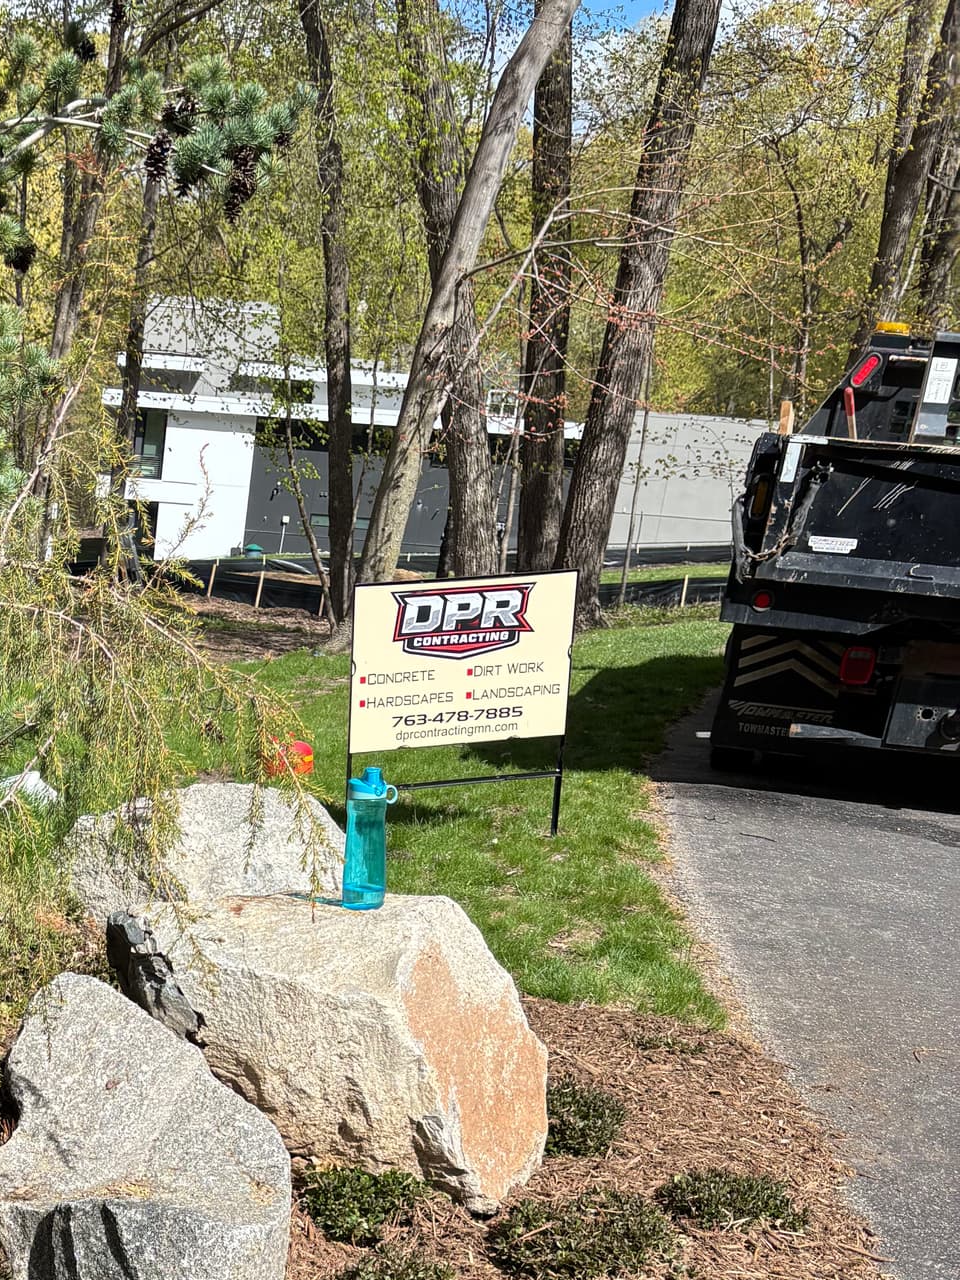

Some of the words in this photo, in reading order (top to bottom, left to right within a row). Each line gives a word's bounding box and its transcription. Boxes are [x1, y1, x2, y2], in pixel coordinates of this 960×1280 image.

[401, 589, 525, 634] DPR
[413, 631, 510, 647] CONTRACTING
[367, 669, 436, 686] CONCRETE
[473, 664, 503, 677] DIRT
[507, 661, 545, 675] WORK
[366, 691, 454, 709] HARDSCAPES
[472, 683, 561, 701] LANDSCAPING
[392, 706, 523, 728] 763-478-7885
[396, 722, 518, 742] dprcontractingmn.com
[738, 722, 790, 738] TOWMASTE
